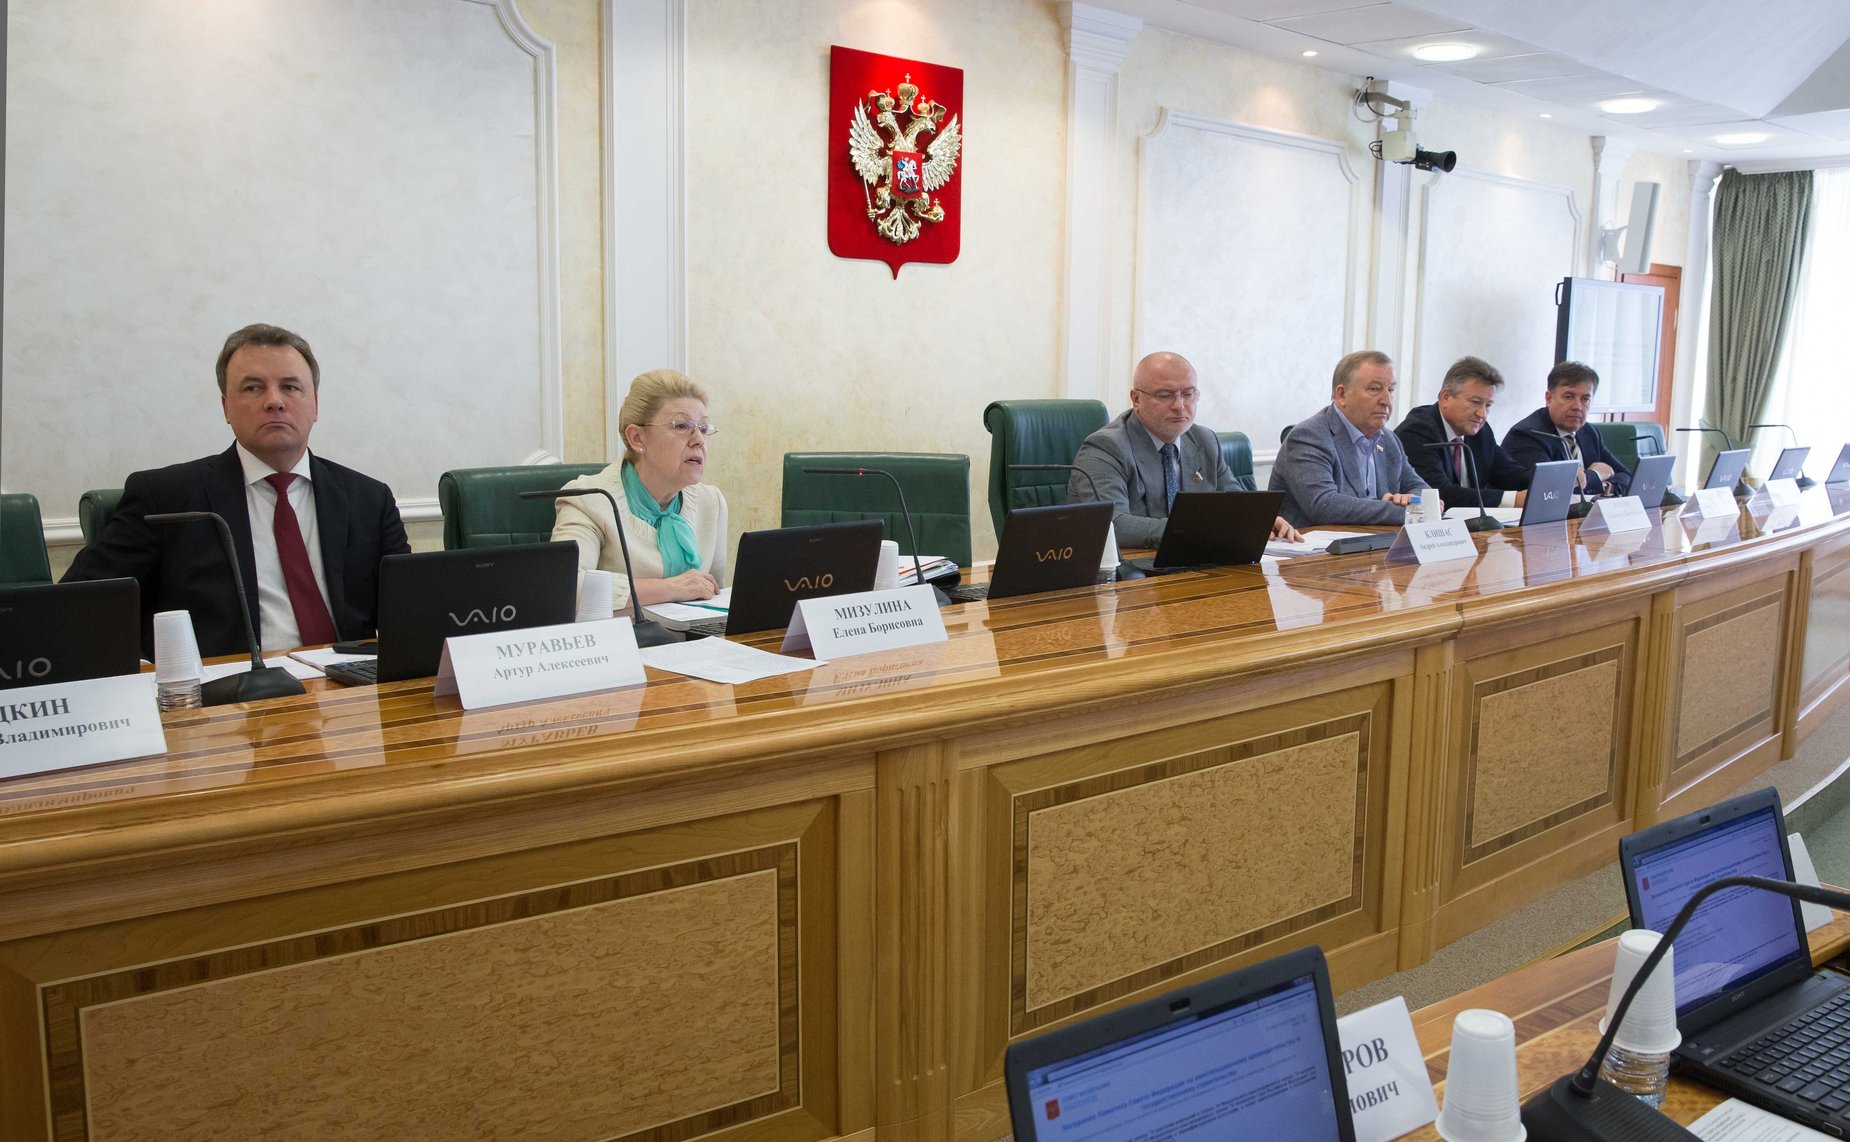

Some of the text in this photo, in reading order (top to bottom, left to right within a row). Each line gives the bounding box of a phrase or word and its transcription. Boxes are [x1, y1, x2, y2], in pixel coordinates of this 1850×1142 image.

[1424, 528, 1453, 539] КЛИШАС
[1036, 547, 1073, 562] VAIO
[784, 573, 834, 592] VAIO
[449, 605, 517, 627] VAIO
[834, 600, 912, 620] МИЗУЛИНА
[833, 617, 924, 639] Елена Борисовна
[496, 634, 597, 659] МУРАВЬЕВ
[494, 655, 609, 680] Артур Алексеевич
